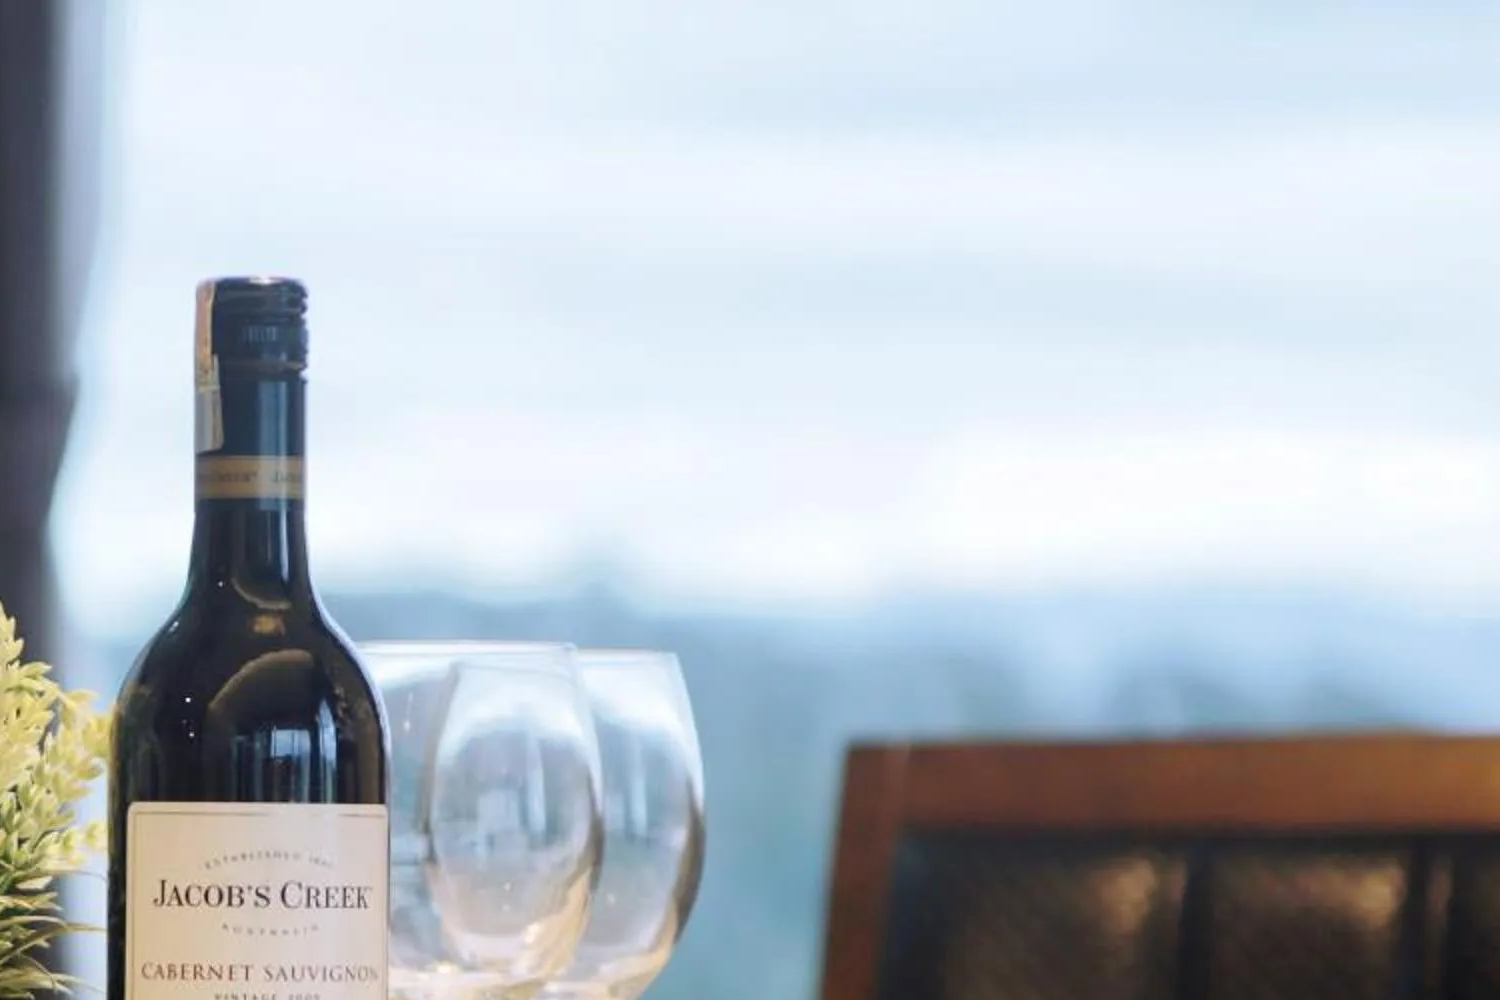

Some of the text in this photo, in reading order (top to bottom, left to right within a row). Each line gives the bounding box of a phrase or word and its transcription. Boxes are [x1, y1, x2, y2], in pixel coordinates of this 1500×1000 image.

[153, 879, 370, 909] JACOB'S CREEK
[141, 961, 379, 984] CABERNET SAUVIGNON
